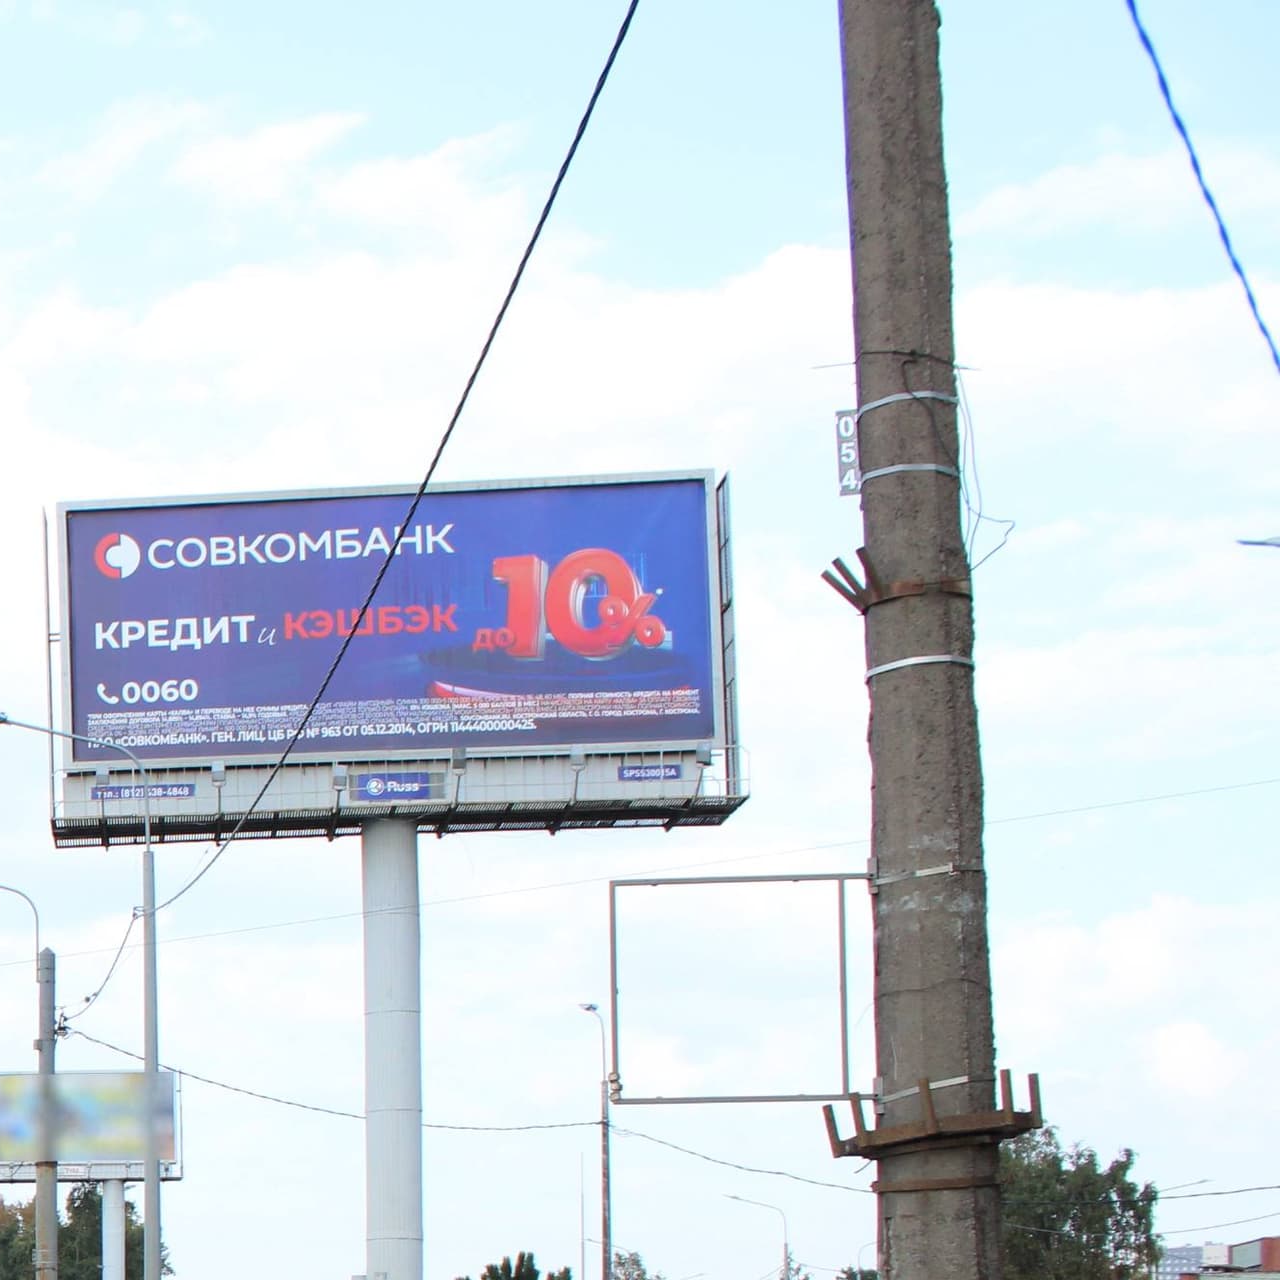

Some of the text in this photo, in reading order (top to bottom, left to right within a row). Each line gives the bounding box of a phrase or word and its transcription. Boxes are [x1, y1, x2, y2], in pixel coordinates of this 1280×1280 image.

[840, 415, 857, 490] 054
[148, 523, 455, 569] СОВКОМБАНК
[95, 604, 458, 651] КРЕДИТ и КЭШБЭК
[473, 627, 516, 653] до
[122, 679, 199, 704] 0060
[211, 731, 235, 743] ГЕН.
[268, 728, 286, 741] ЦБ
[306, 726, 319, 738] №
[322, 725, 341, 738] 963
[343, 725, 359, 737] ОТ
[361, 721, 416, 737] 05.12.2014,
[418, 720, 448, 734] ОГРН
[121, 787, 144, 798] (812)
[386, 781, 420, 793] Russ
